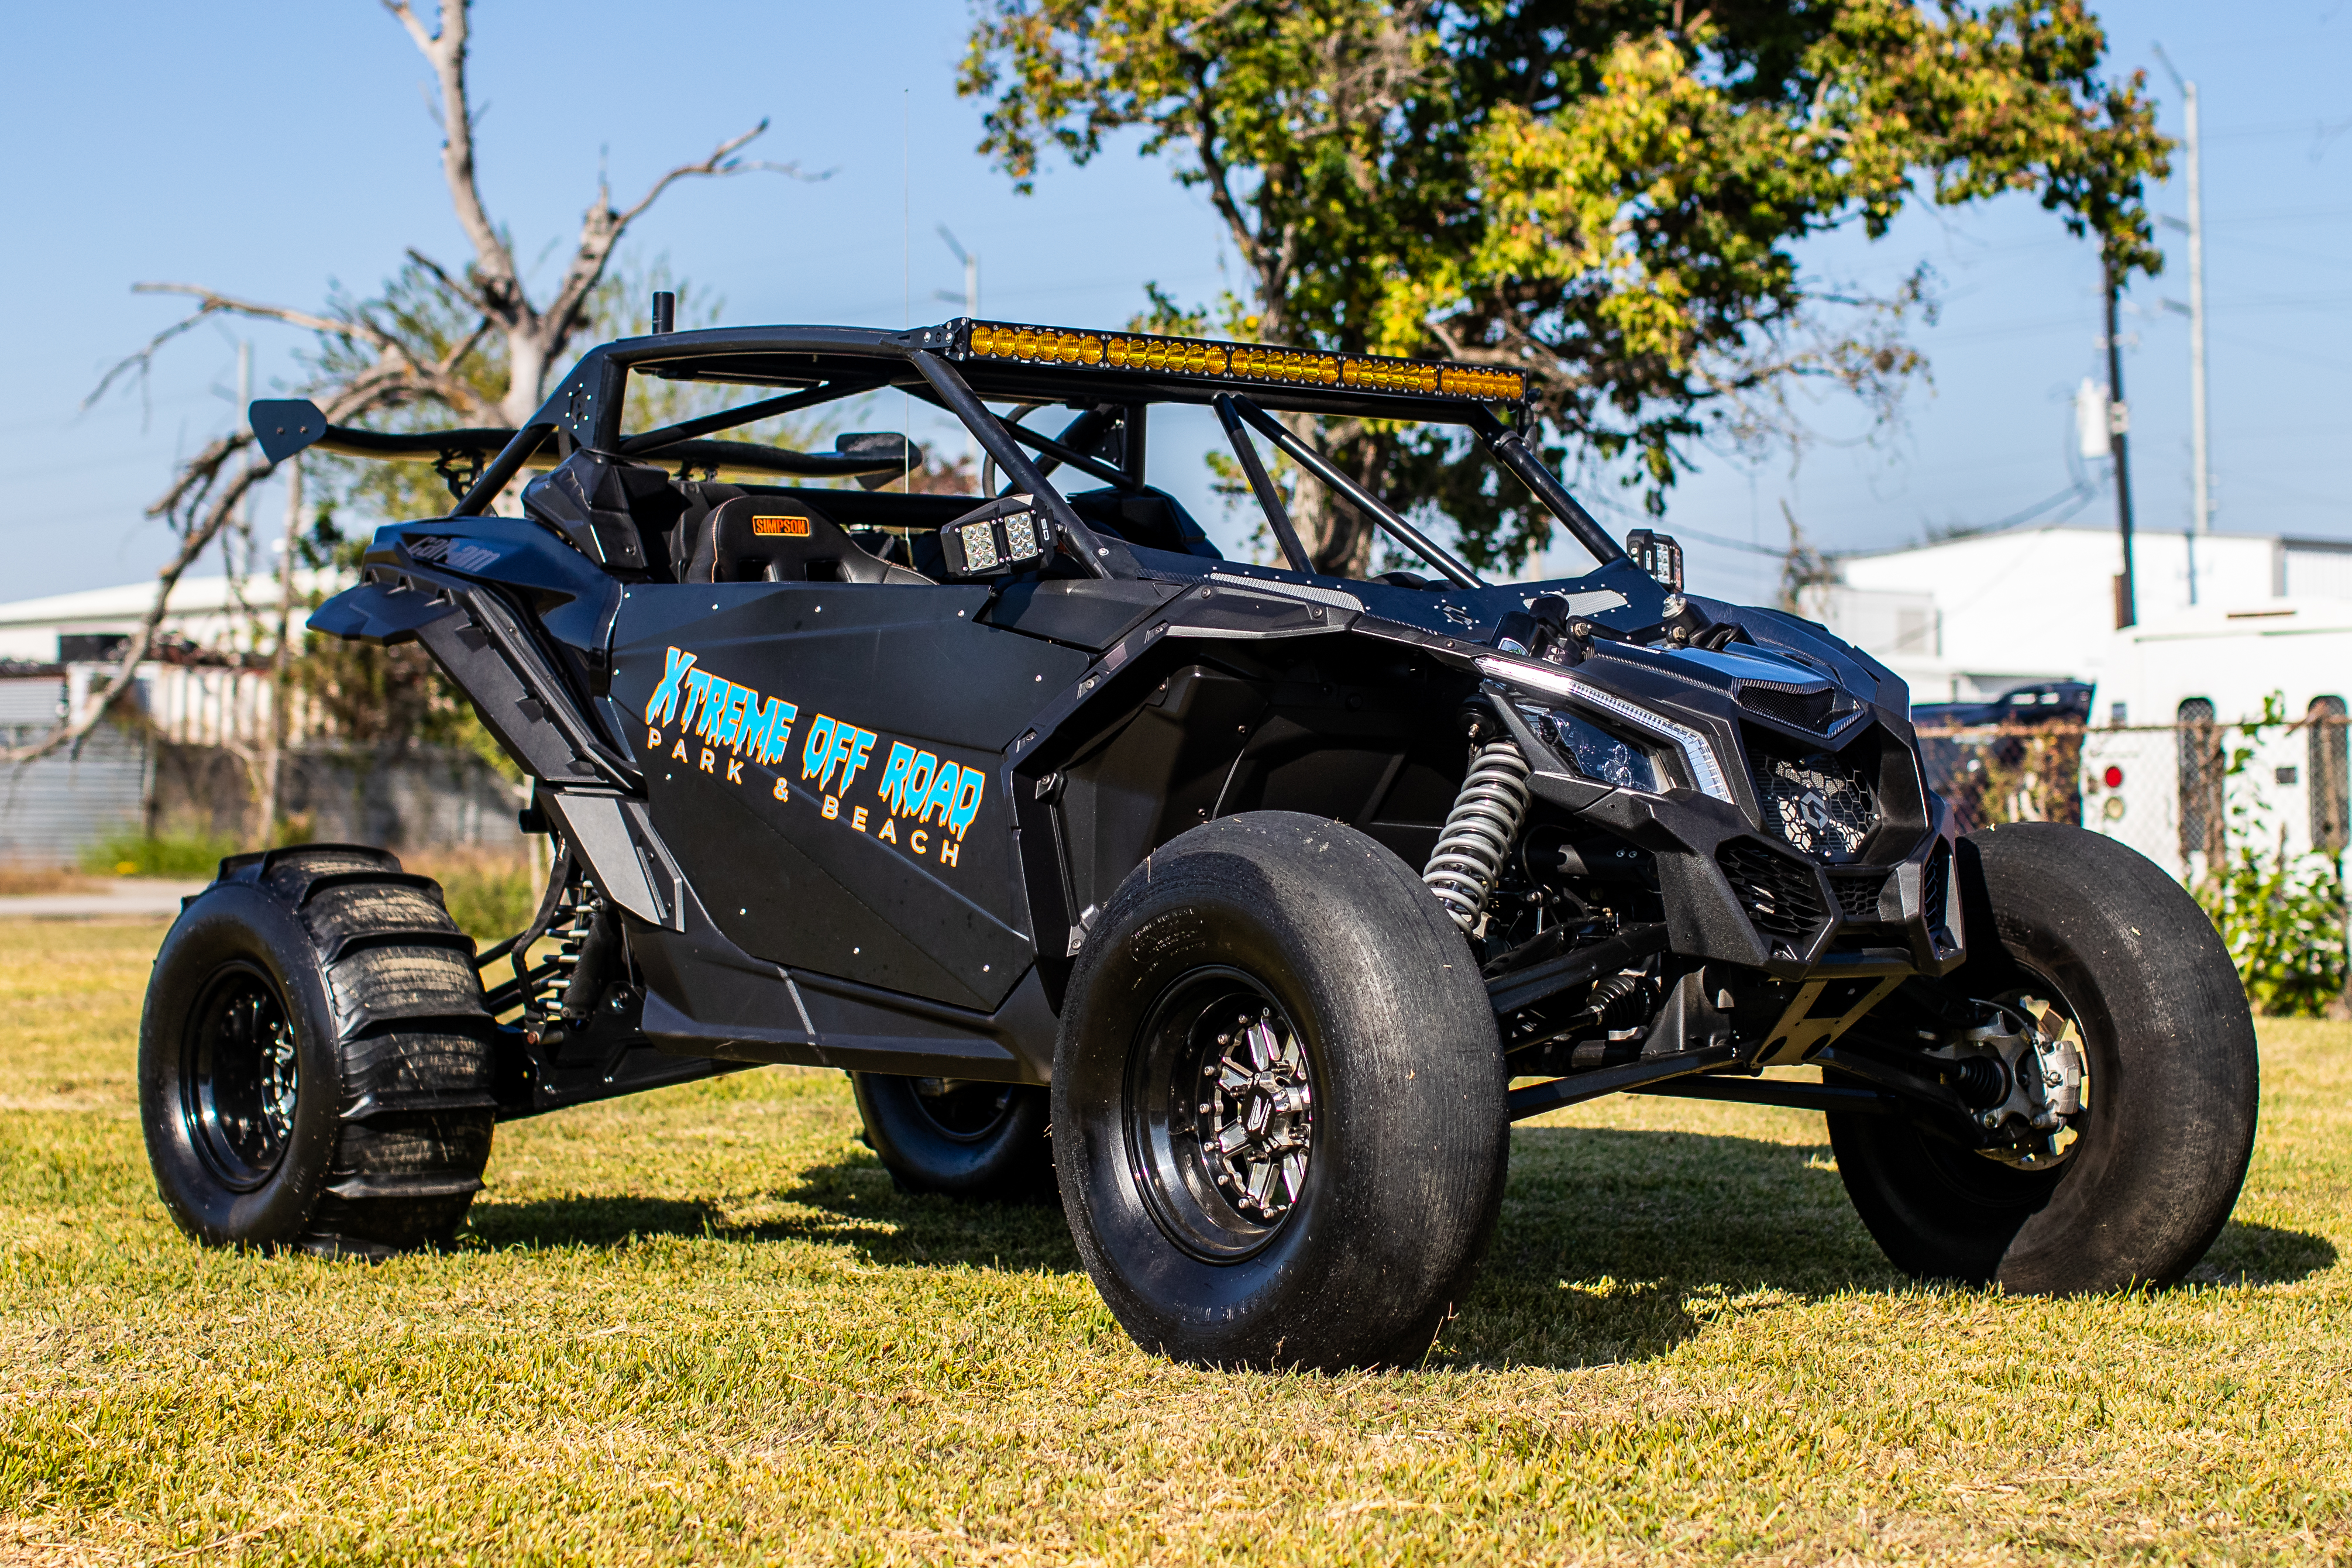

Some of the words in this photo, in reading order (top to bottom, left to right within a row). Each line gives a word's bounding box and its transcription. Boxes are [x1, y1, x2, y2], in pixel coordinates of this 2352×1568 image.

[756, 518, 806, 534] SIMPSON
[645, 645, 799, 766] XTREME
[802, 713, 878, 798] OFF
[878, 740, 985, 842] ROAD
[647, 727, 742, 784] PARK
[773, 777, 789, 802] &
[821, 793, 960, 867] BEACH
